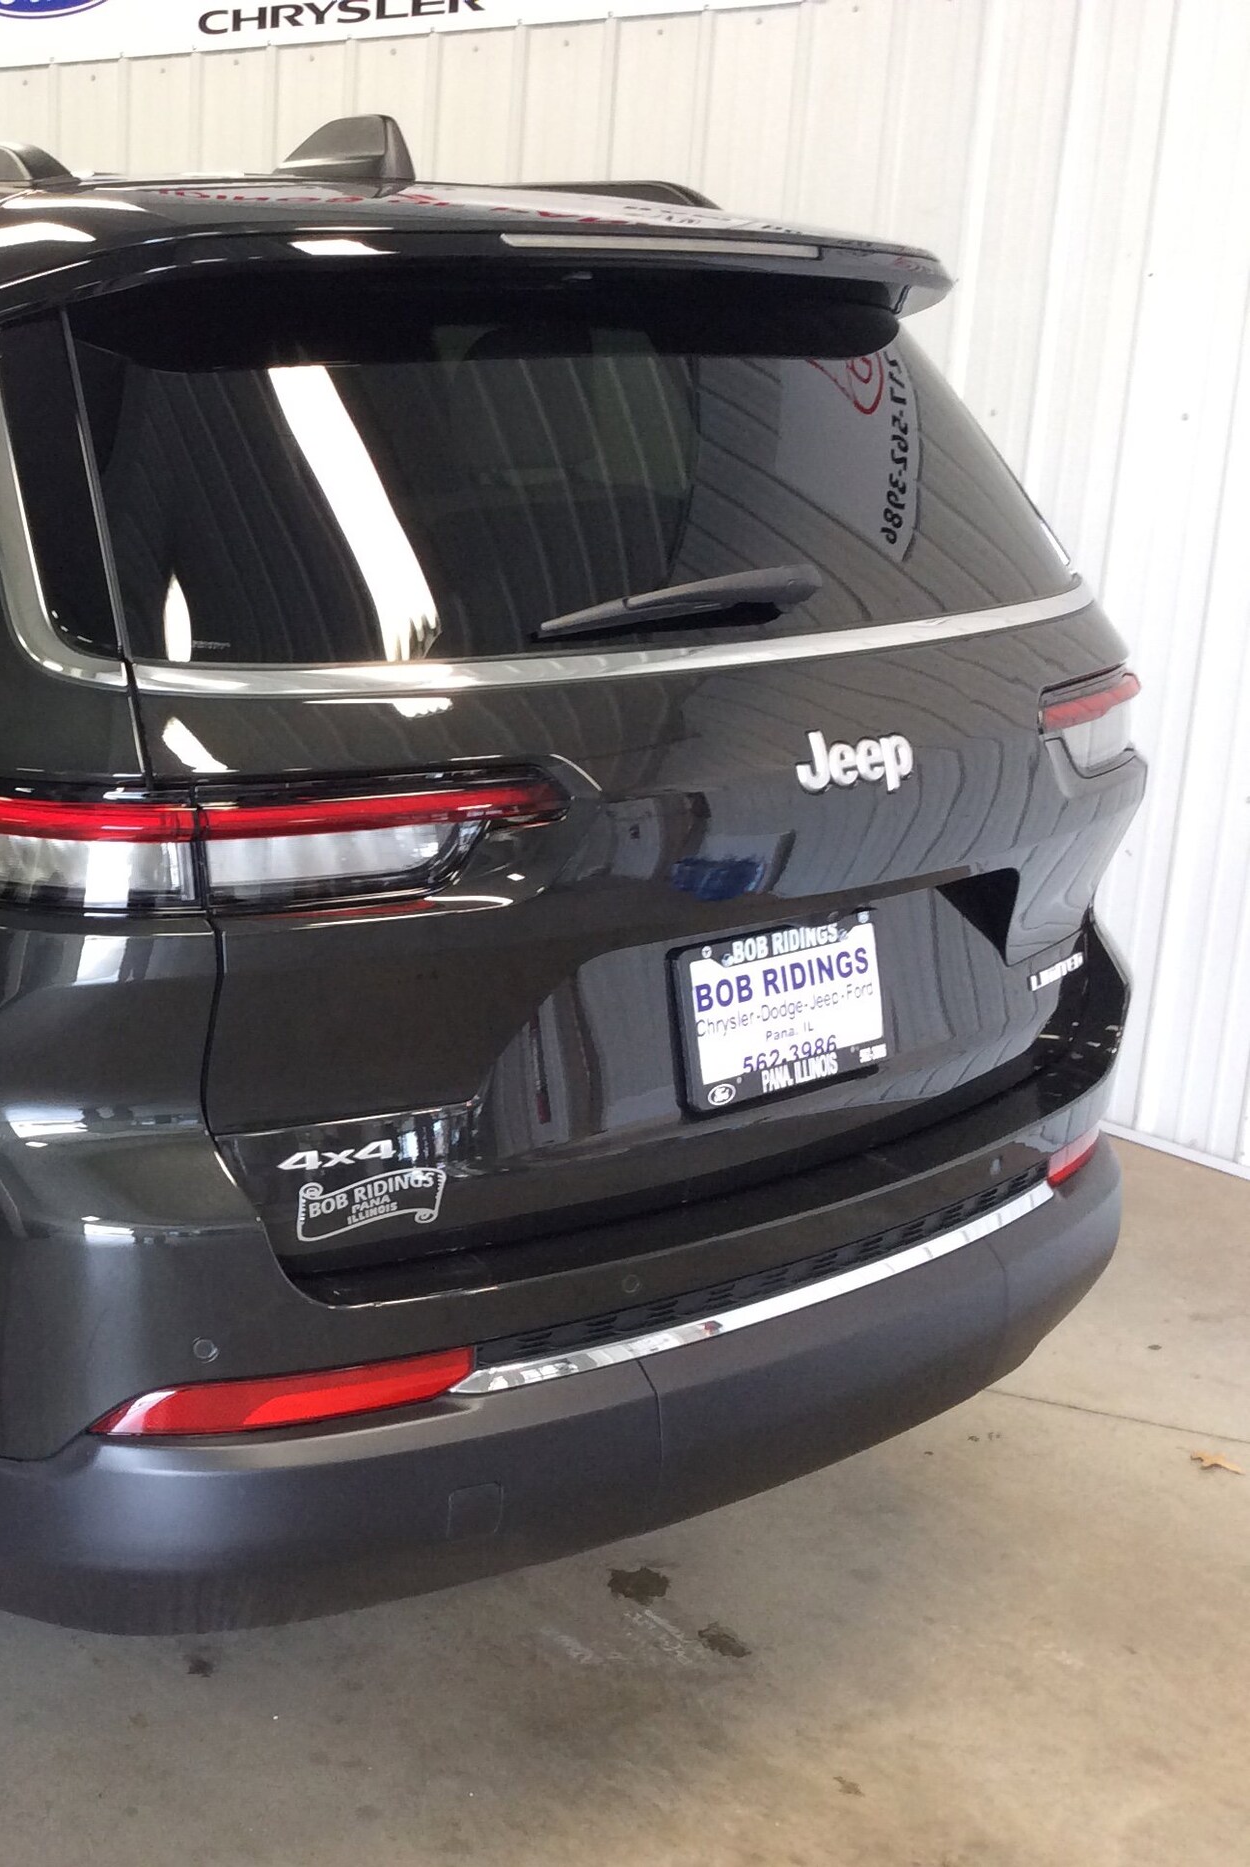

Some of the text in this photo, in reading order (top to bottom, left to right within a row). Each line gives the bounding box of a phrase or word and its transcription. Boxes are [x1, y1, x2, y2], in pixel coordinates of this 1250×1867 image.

[796, 731, 913, 791] Jeep
[732, 923, 838, 964] BOB RIDINGS
[695, 947, 869, 1012] BOB RIDINGS
[803, 1021, 814, 1032] IL
[793, 1052, 838, 1084] ILLINOIS
[277, 1139, 397, 1170] 4x4
[308, 1172, 434, 1219] BOB RIDINGS
[352, 1194, 391, 1214] PANA
[347, 1201, 398, 1225] ILLINOIS
